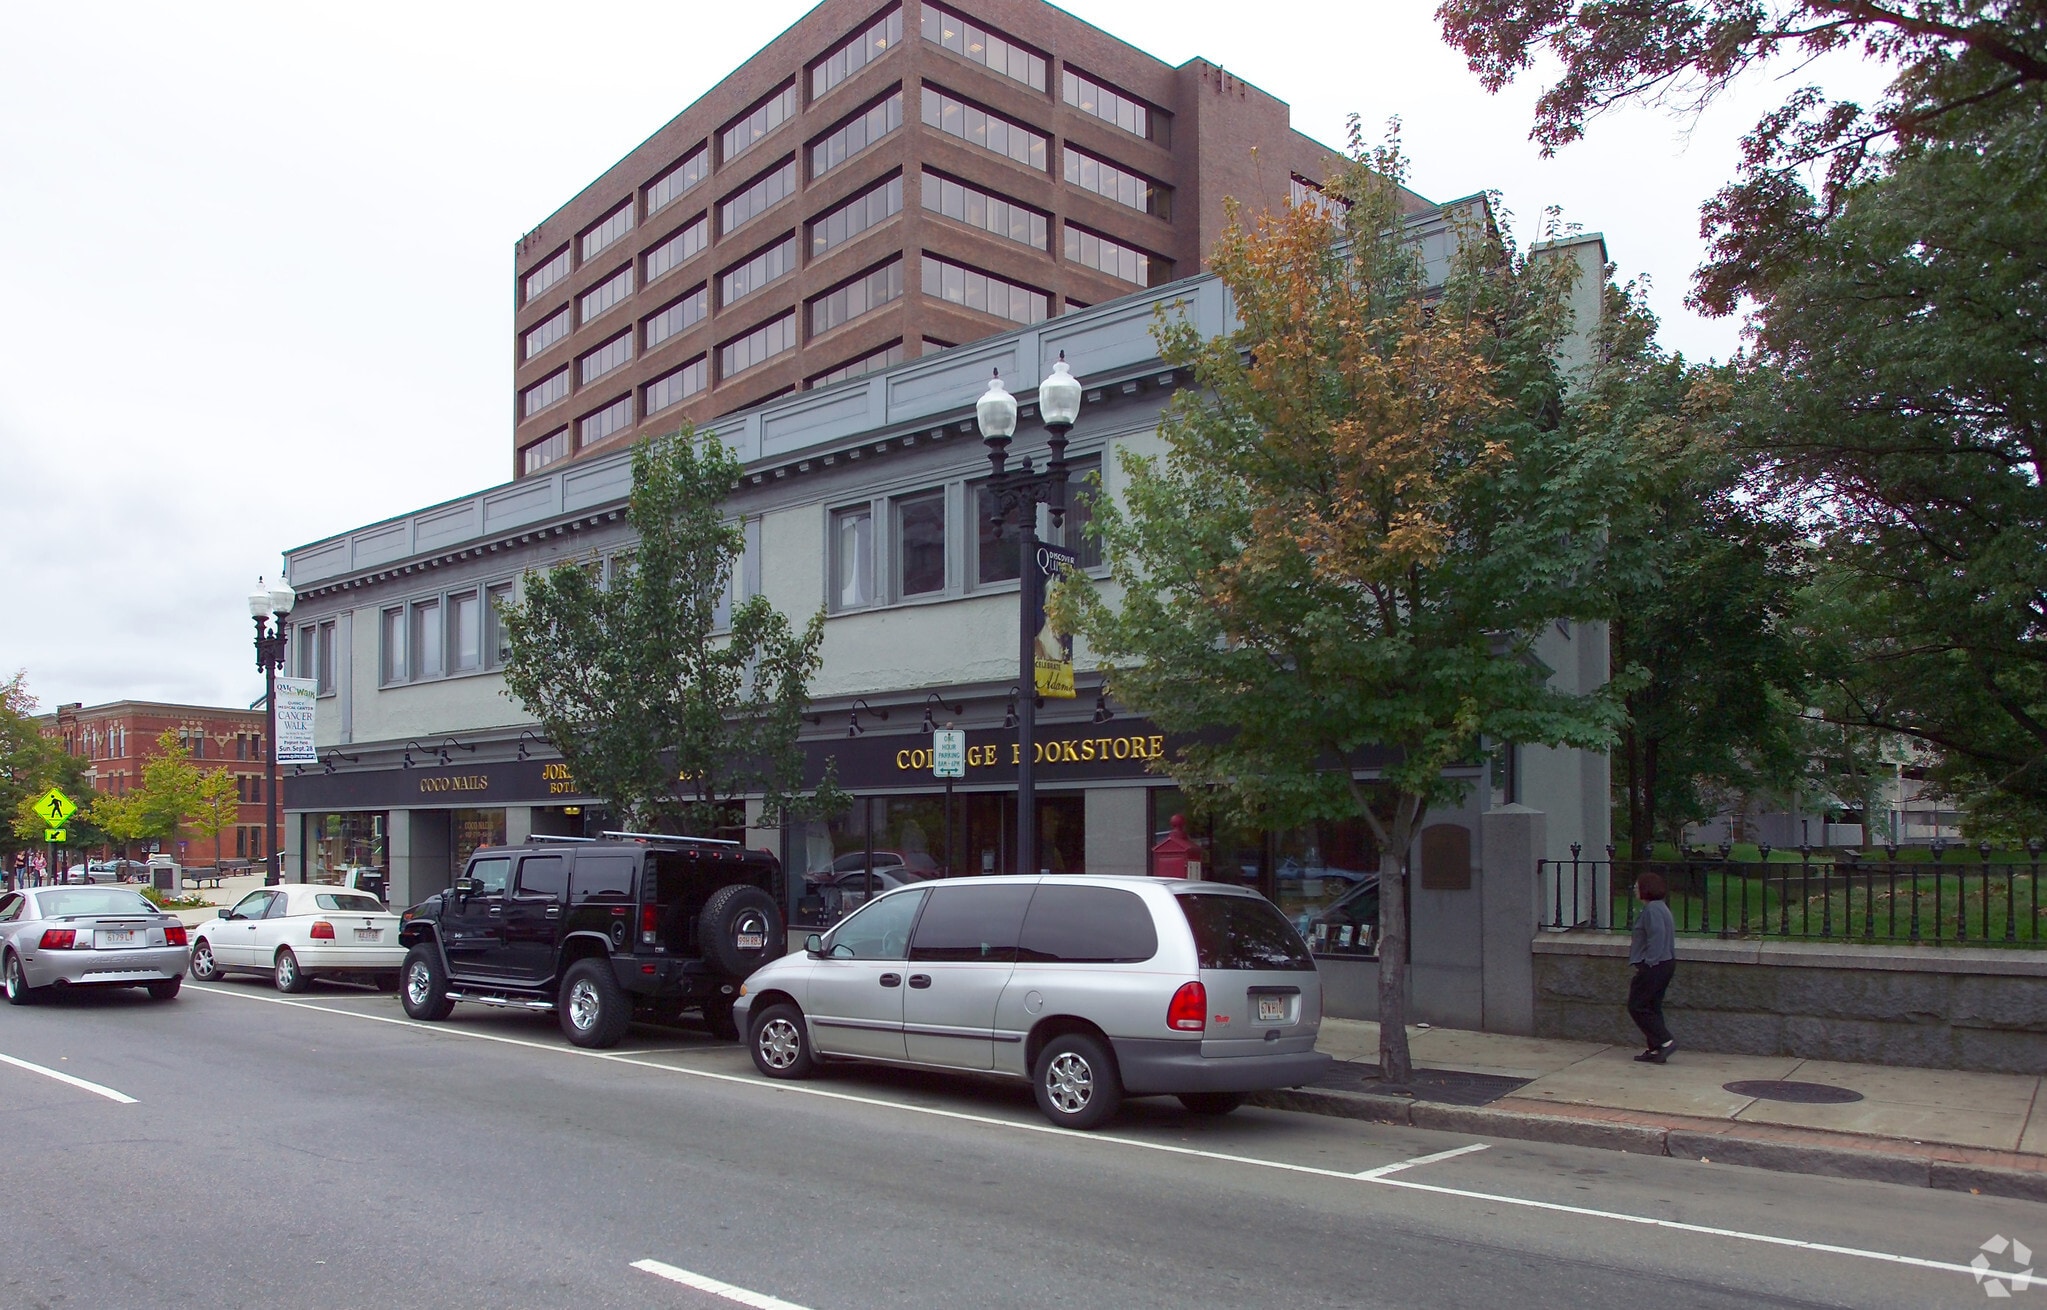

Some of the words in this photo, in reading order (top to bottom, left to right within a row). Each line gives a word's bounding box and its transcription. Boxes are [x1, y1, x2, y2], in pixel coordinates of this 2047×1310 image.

[1049, 552, 1075, 564] DISCOVER
[278, 711, 312, 720] CANCER
[284, 721, 307, 730] WALK
[896, 745, 998, 769] COLGE
[420, 777, 450, 792] COCO
[452, 775, 488, 790] NAILS
